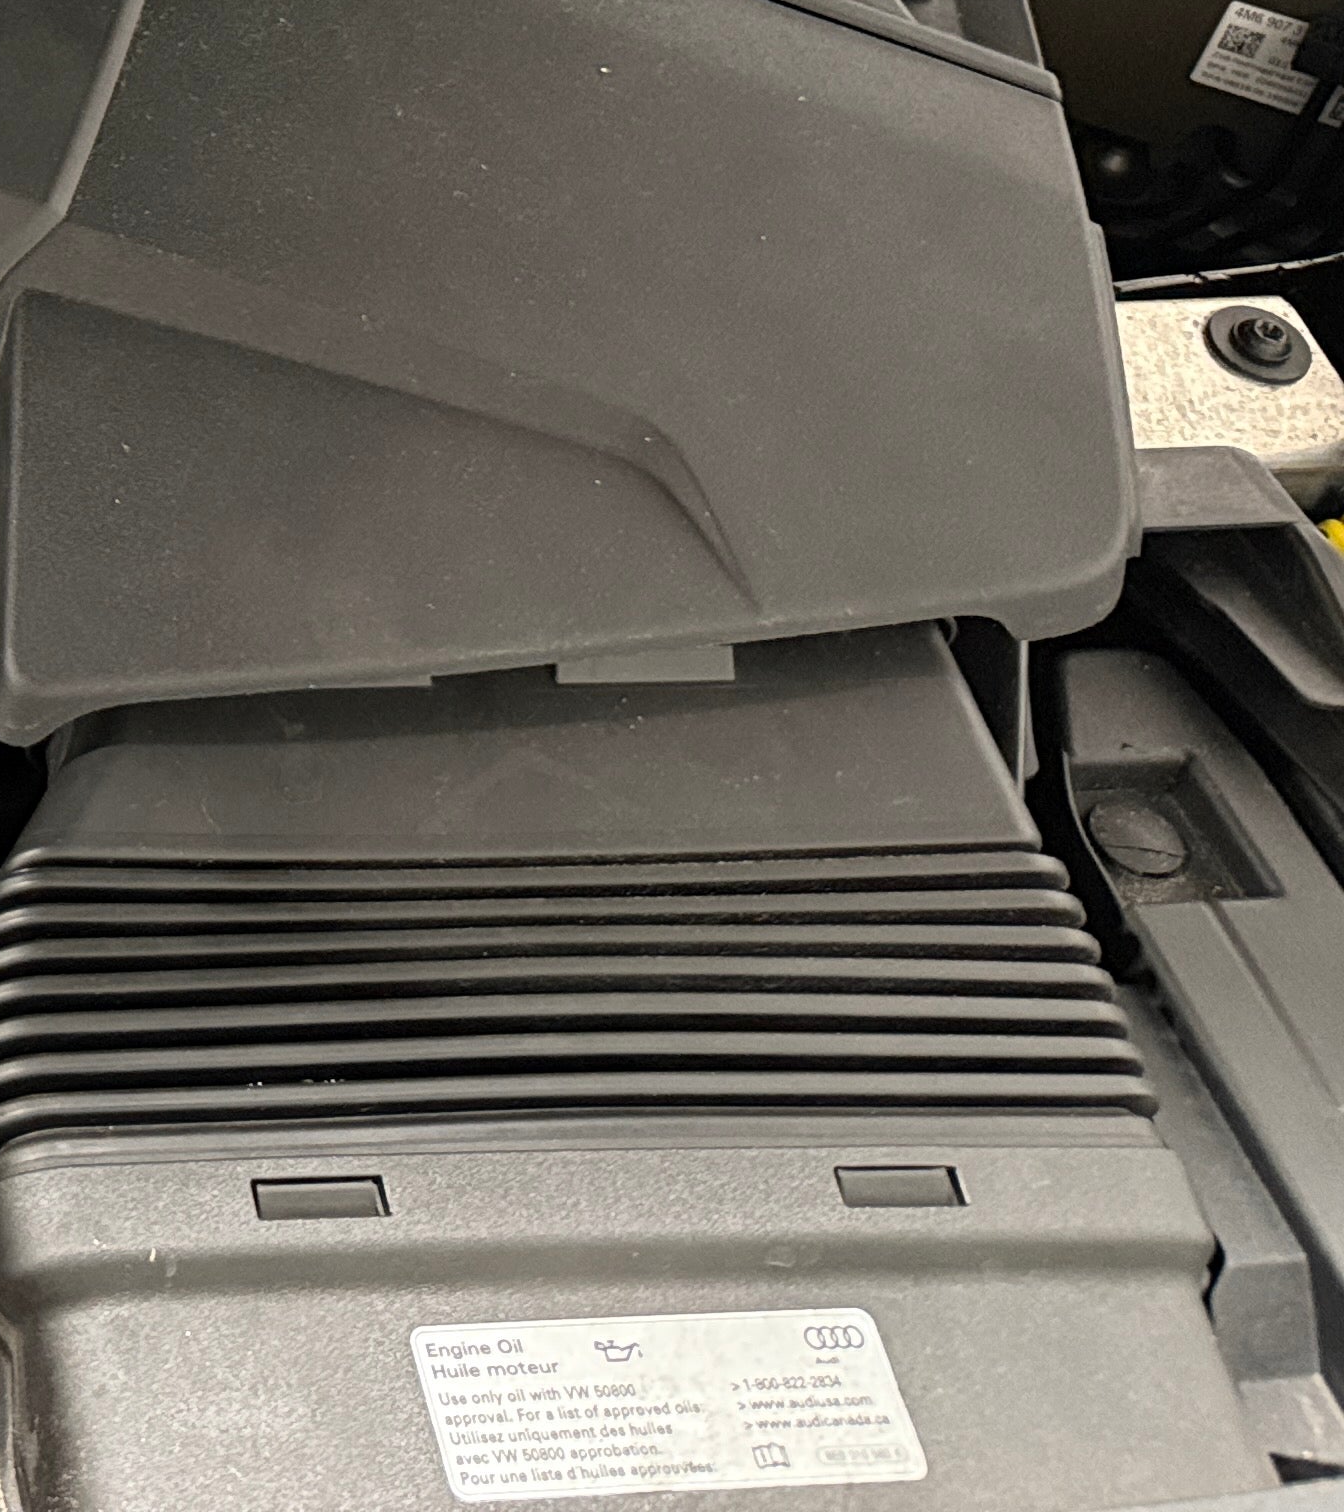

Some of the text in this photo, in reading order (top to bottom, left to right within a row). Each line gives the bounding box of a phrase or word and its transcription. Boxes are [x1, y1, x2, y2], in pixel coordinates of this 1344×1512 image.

[425, 1338, 524, 1360] Engine Oil
[431, 1361, 559, 1380] Huile moteur
[438, 1383, 637, 1406] Use only oil with VW 50800
[751, 1394, 874, 1410] www.audiusa.com
[445, 1408, 514, 1428] approval.
[517, 1407, 541, 1422] For
[546, 1410, 555, 1421] a
[557, 1405, 582, 1420] list
[585, 1404, 599, 1419] of
[603, 1401, 672, 1420] approved
[755, 1413, 891, 1429] www.audicanada.ca
[449, 1430, 504, 1445] Utilisez
[508, 1427, 597, 1444] uniquement
[600, 1424, 626, 1438] des
[456, 1453, 490, 1466] avec
[492, 1448, 518, 1464] VW
[522, 1446, 565, 1462] 50800
[460, 1471, 495, 1486] Pour
[500, 1471, 528, 1484] une
[531, 1467, 563, 1482] liste
